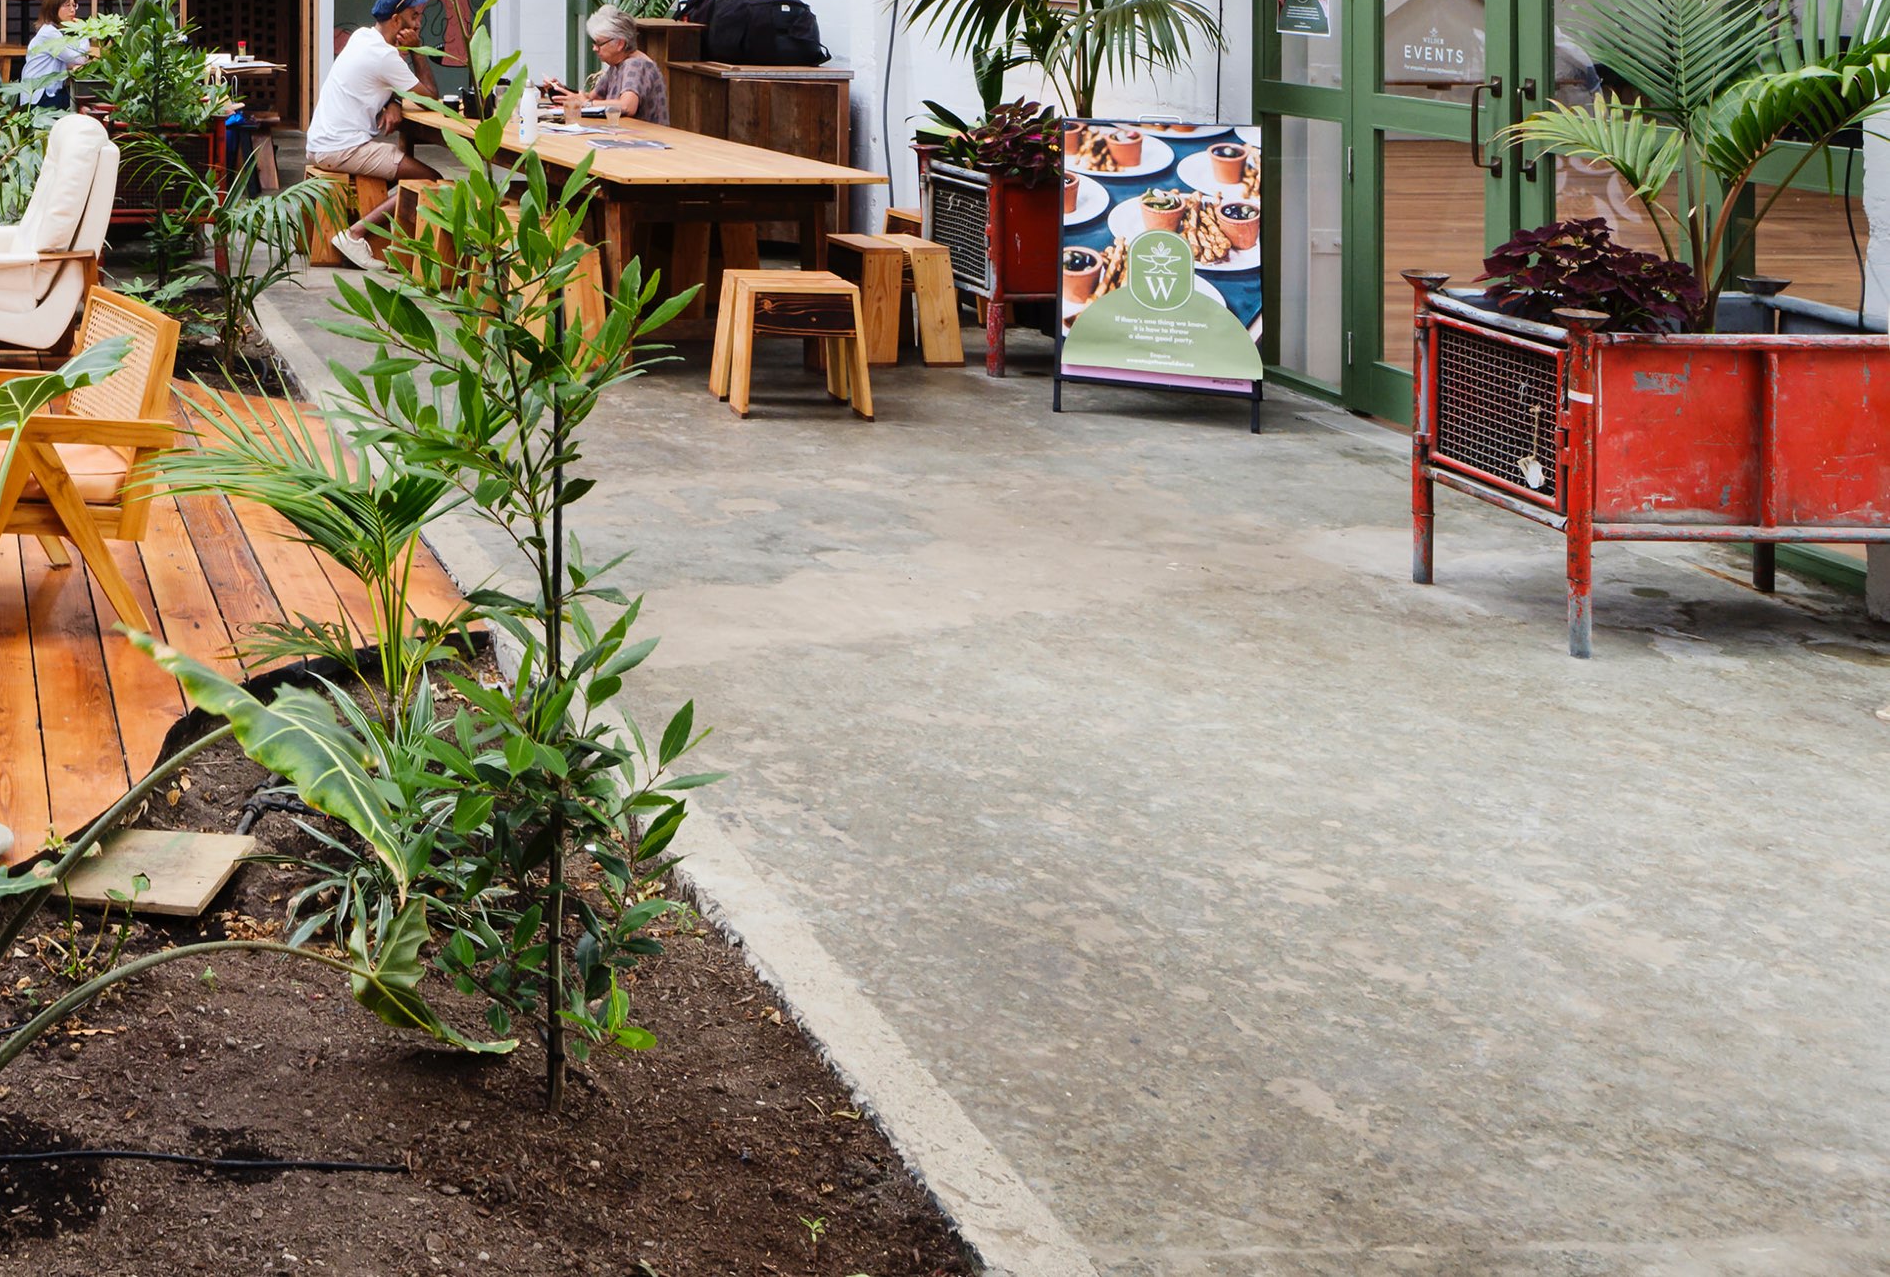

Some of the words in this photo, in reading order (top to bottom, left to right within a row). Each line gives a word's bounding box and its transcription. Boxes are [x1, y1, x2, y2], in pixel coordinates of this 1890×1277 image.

[1404, 44, 1464, 64] EVENTS
[1144, 275, 1178, 301] W
[1155, 335, 1173, 343] good
